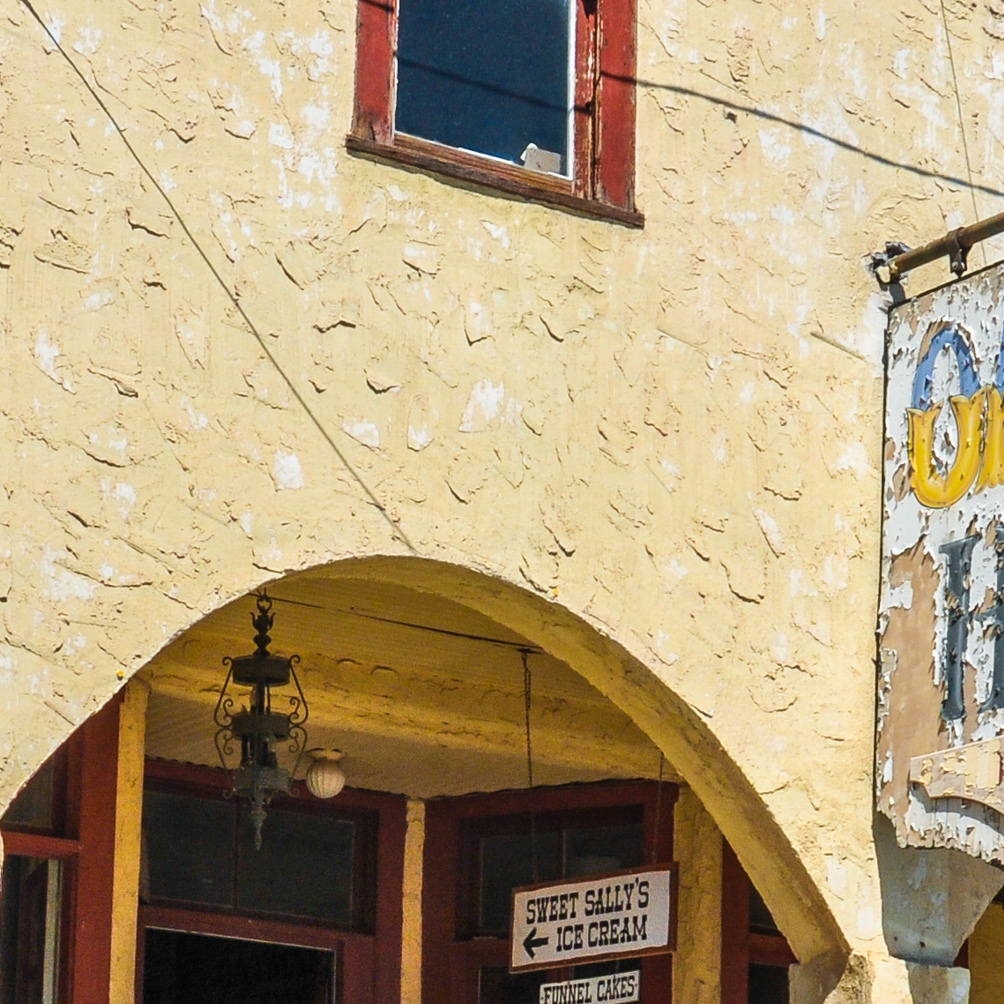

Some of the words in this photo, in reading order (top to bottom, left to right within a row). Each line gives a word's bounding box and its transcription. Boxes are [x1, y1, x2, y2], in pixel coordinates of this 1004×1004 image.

[526, 891, 579, 925] SWEET
[585, 877, 650, 917] SALLY'S
[556, 923, 584, 952] ICE
[588, 914, 648, 948] CREAM
[596, 974, 636, 1002] CAKES
